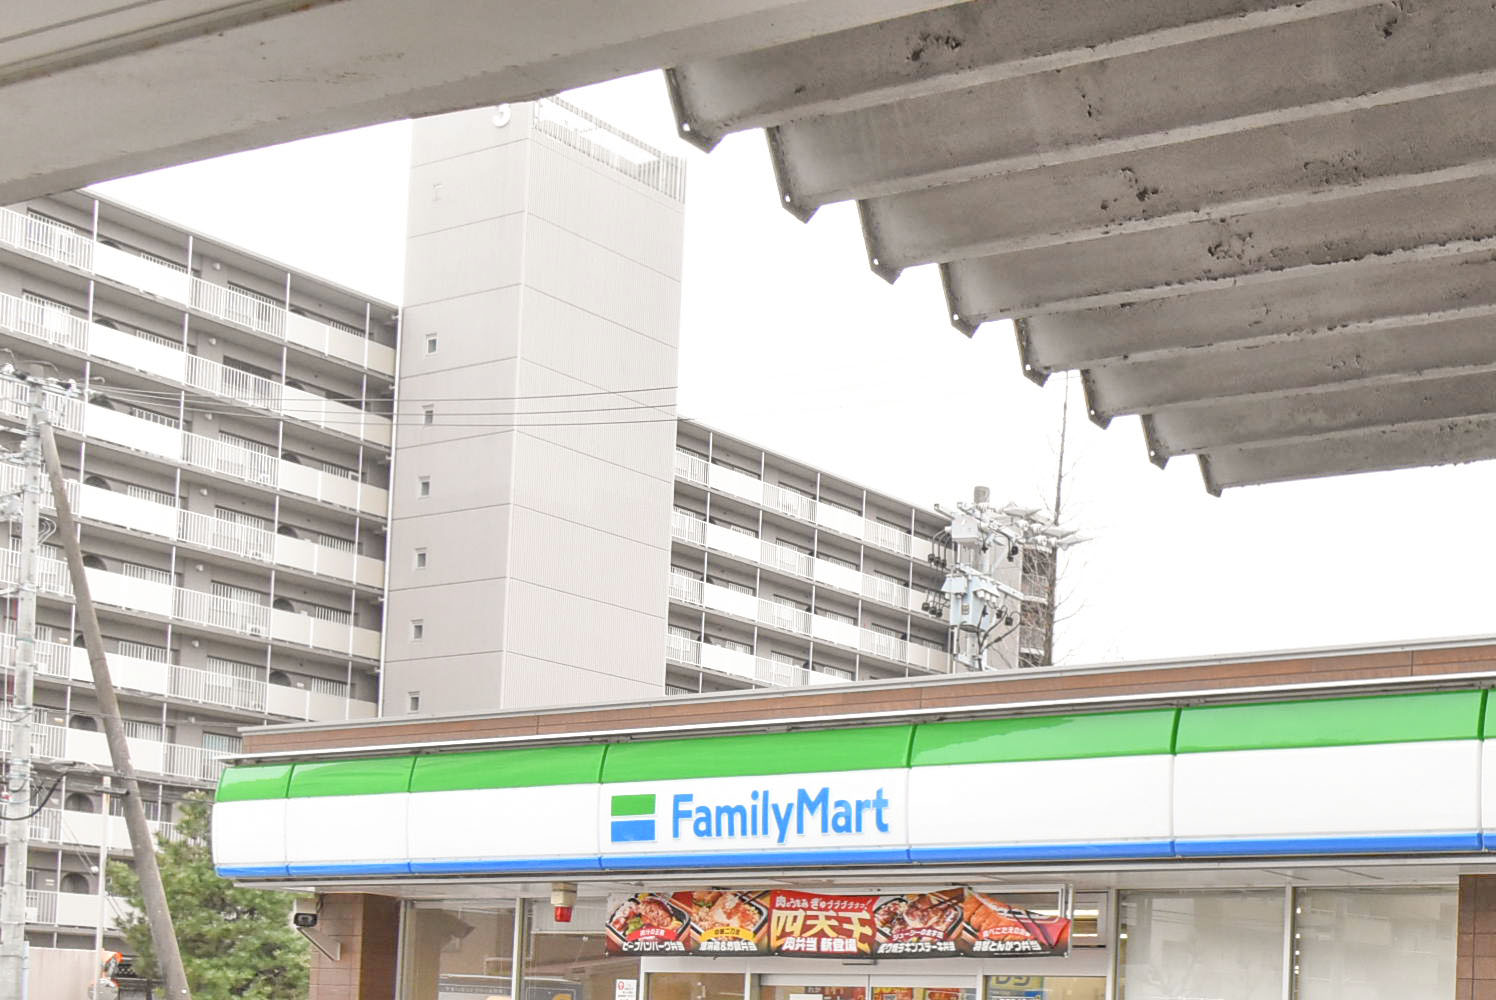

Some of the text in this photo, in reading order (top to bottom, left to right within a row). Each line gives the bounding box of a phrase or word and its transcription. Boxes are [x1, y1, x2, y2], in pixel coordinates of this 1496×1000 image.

[671, 787, 890, 846] FamilyMart
[770, 908, 873, 953] 四天王
